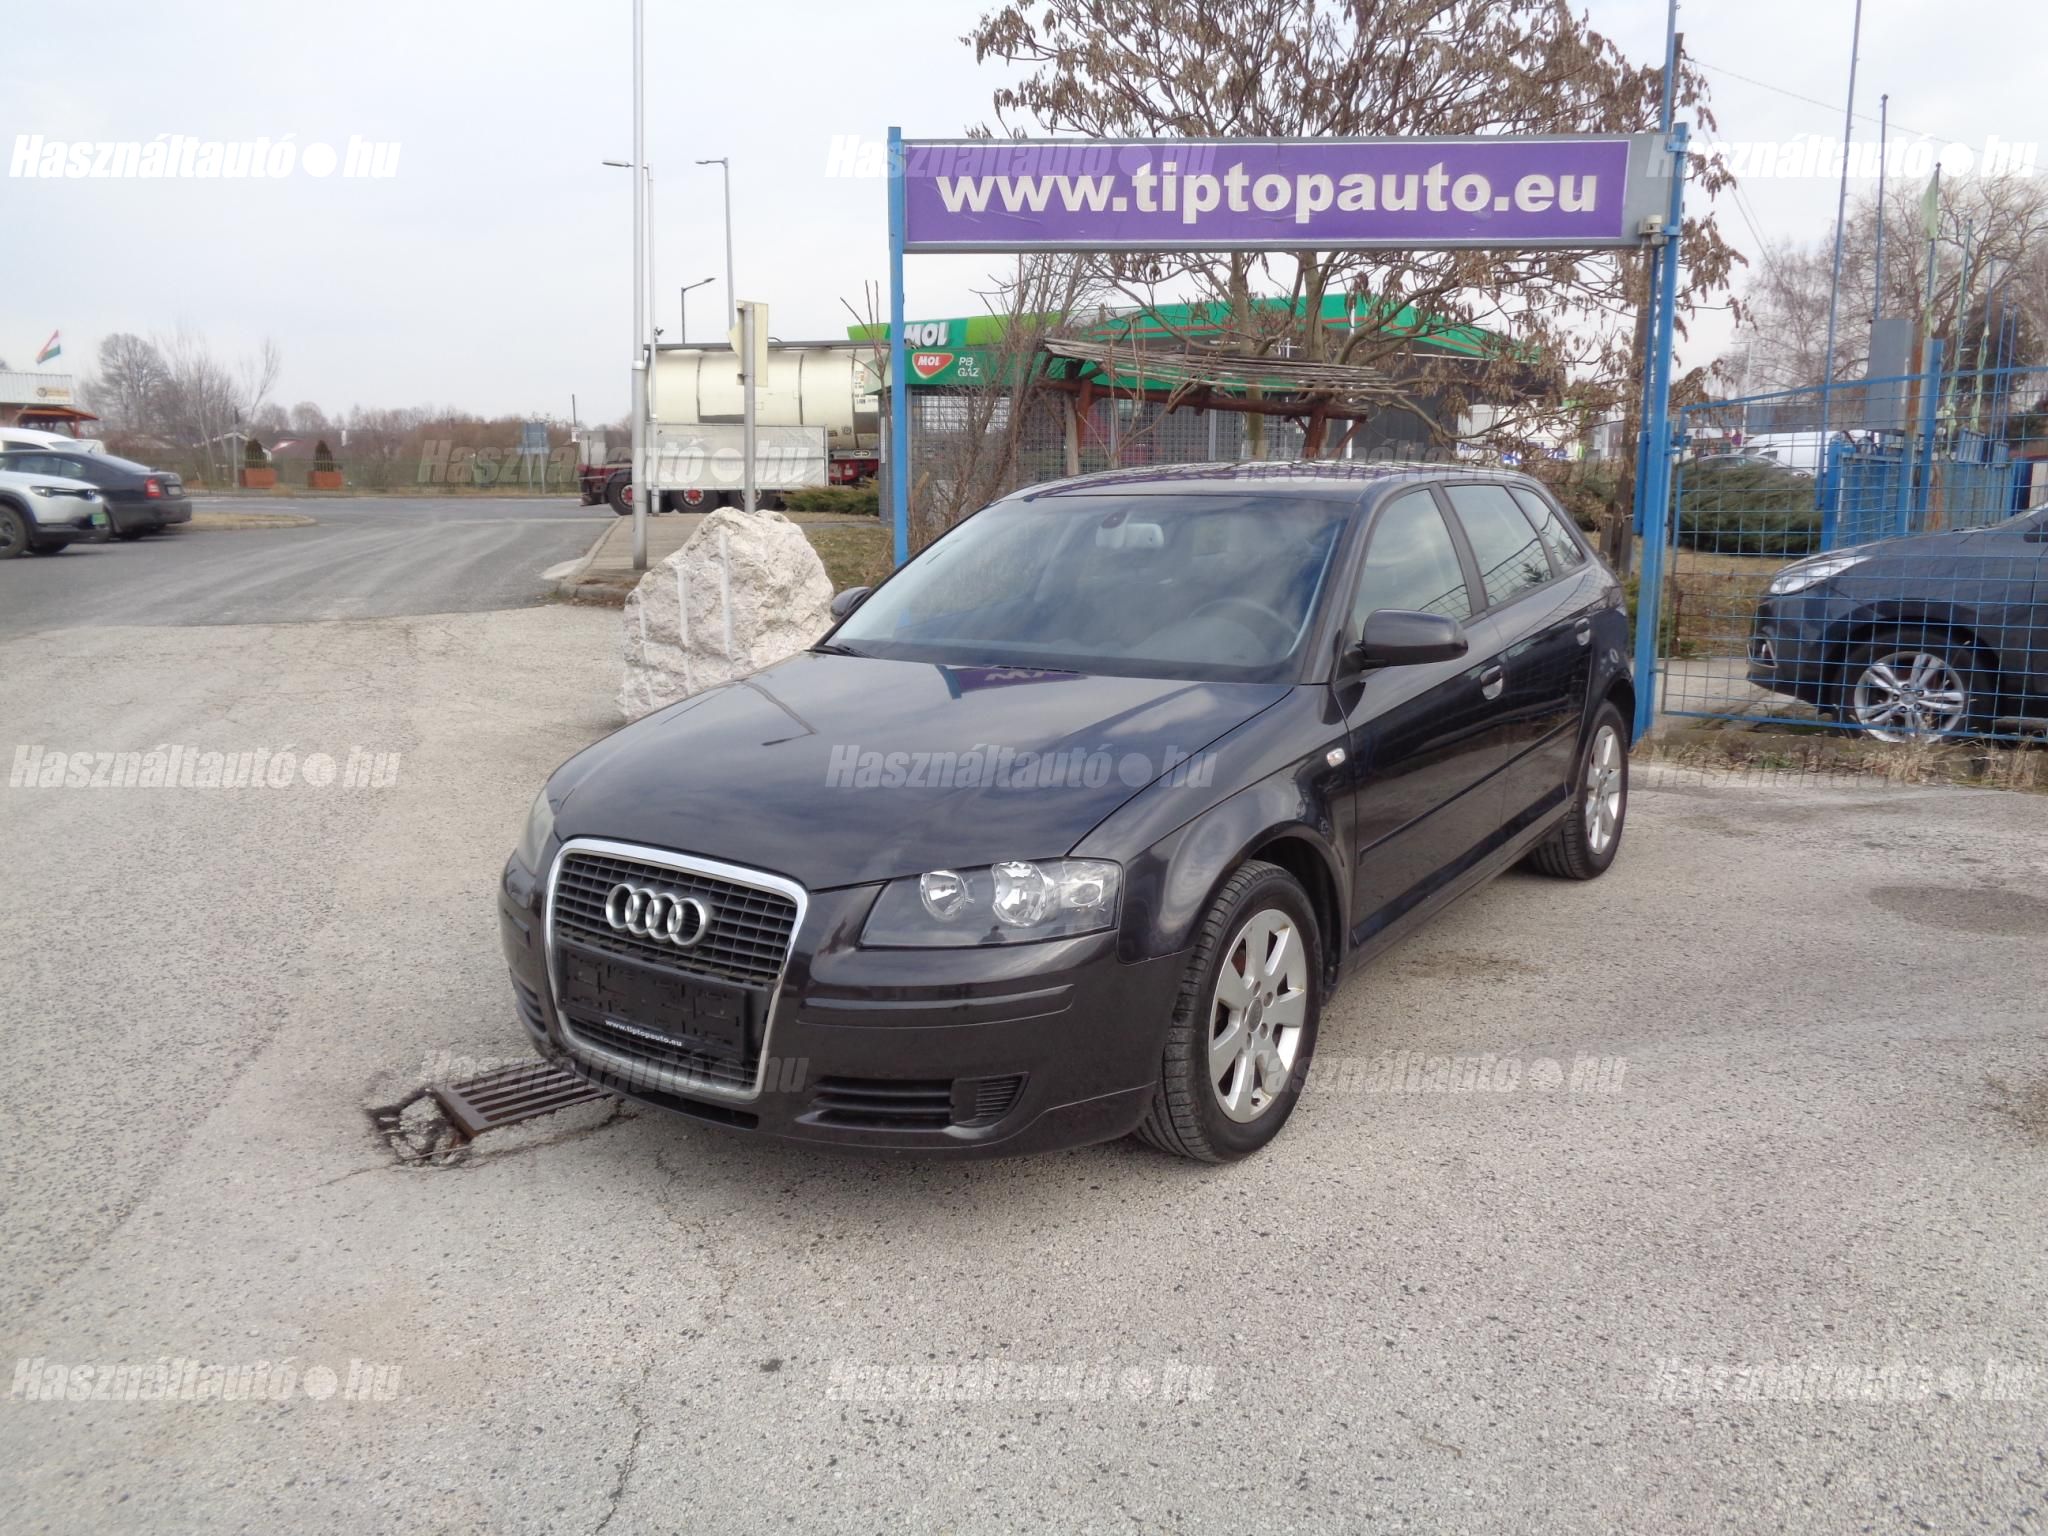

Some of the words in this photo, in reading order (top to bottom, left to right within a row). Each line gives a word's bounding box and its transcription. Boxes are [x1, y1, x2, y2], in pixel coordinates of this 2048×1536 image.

[936, 160, 1599, 225] www.tiptopauto.eu
[904, 322, 949, 347] MOL
[917, 355, 941, 367] MOL
[958, 356, 974, 367] PB
[604, 1019, 683, 1047] www.tiptopauto.eu
